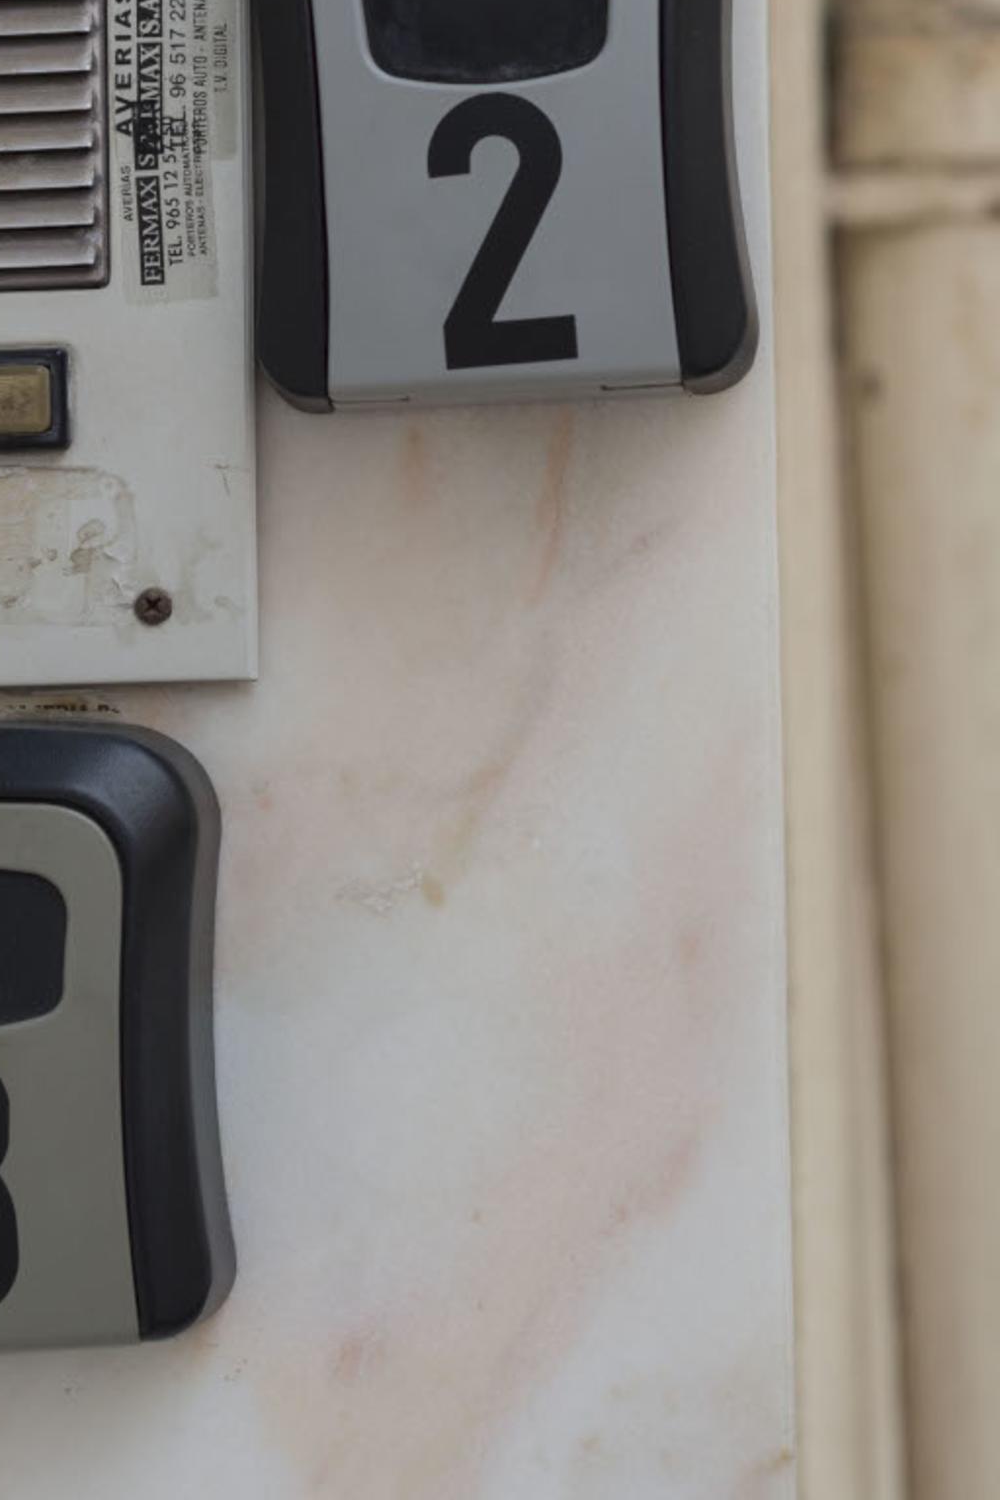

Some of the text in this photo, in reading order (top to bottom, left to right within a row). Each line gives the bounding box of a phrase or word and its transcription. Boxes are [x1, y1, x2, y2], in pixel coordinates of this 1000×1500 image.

[170, 28, 186, 65] 517
[213, 22, 228, 69] DIGITAL
[170, 73, 186, 98] 96
[193, 56, 208, 87] AUTO
[163, 170, 179, 190] 12
[139, 178, 162, 282] FERMAX
[165, 197, 181, 230] 965
[427, 91, 578, 370] 2
[168, 236, 183, 266] TEL.
